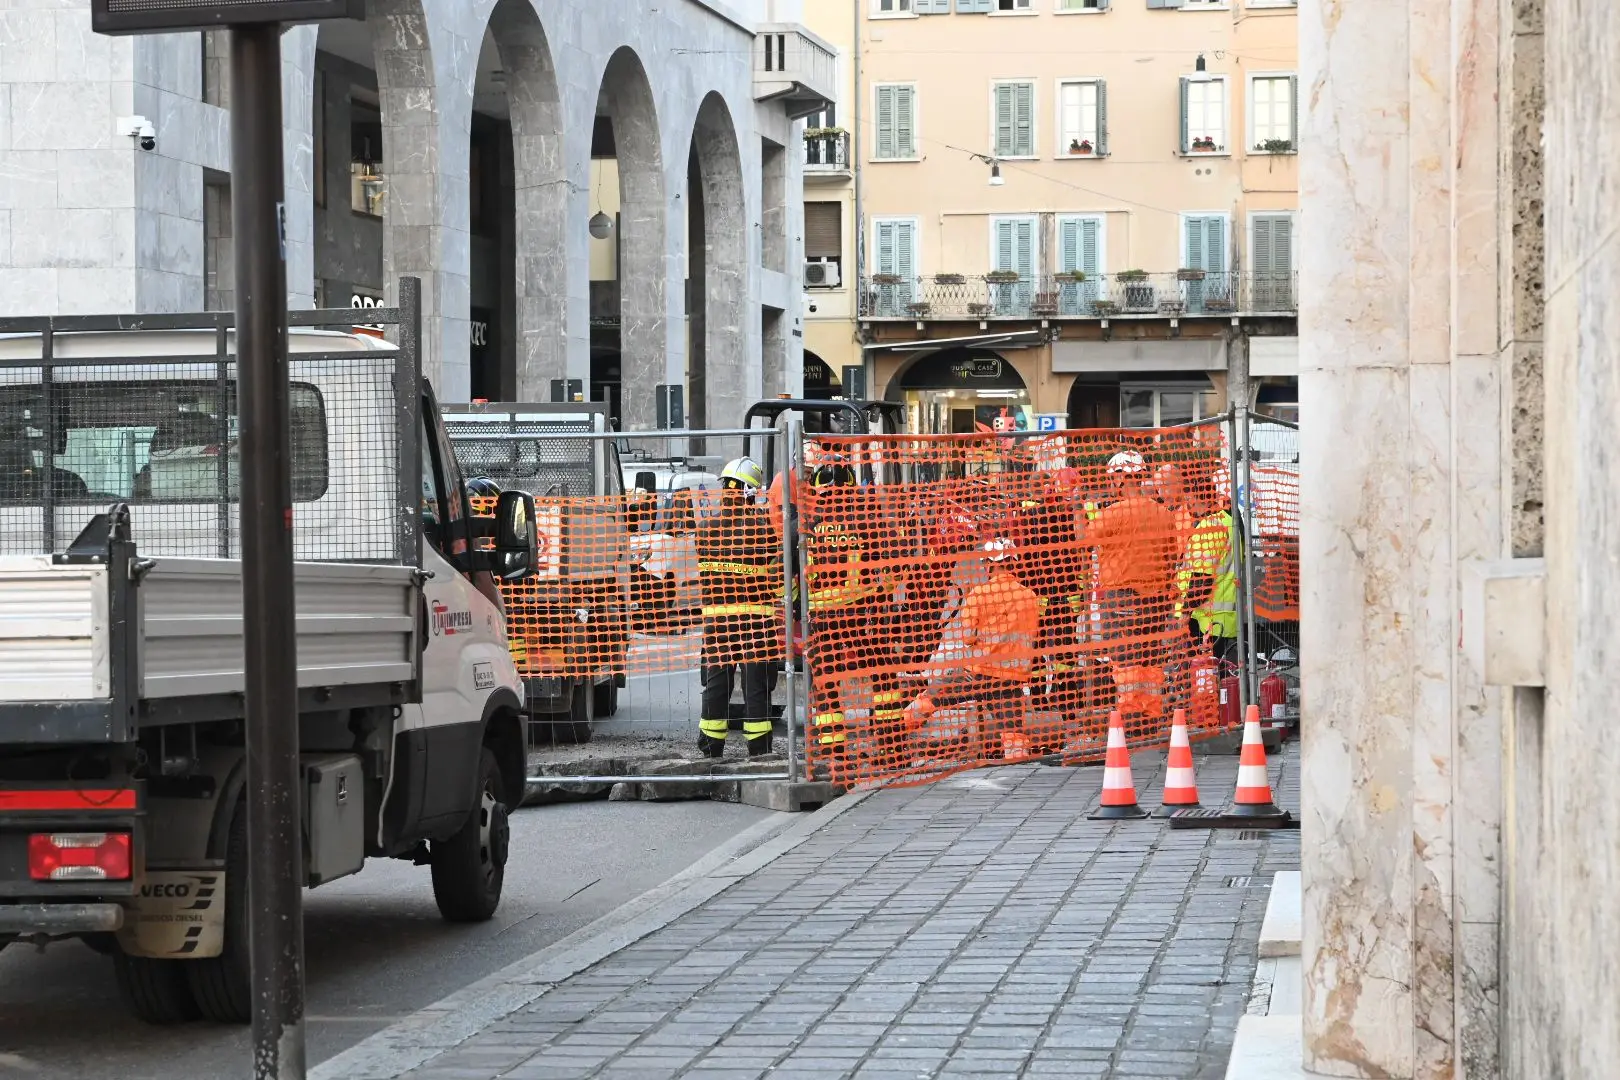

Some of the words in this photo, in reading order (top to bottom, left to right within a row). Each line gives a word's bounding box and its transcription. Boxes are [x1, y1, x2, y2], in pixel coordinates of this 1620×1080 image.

[470, 321, 488, 346] KFC
[1040, 417, 1052, 431] P
[135, 883, 190, 898] VECO
[175, 914, 204, 922] DIESEL
